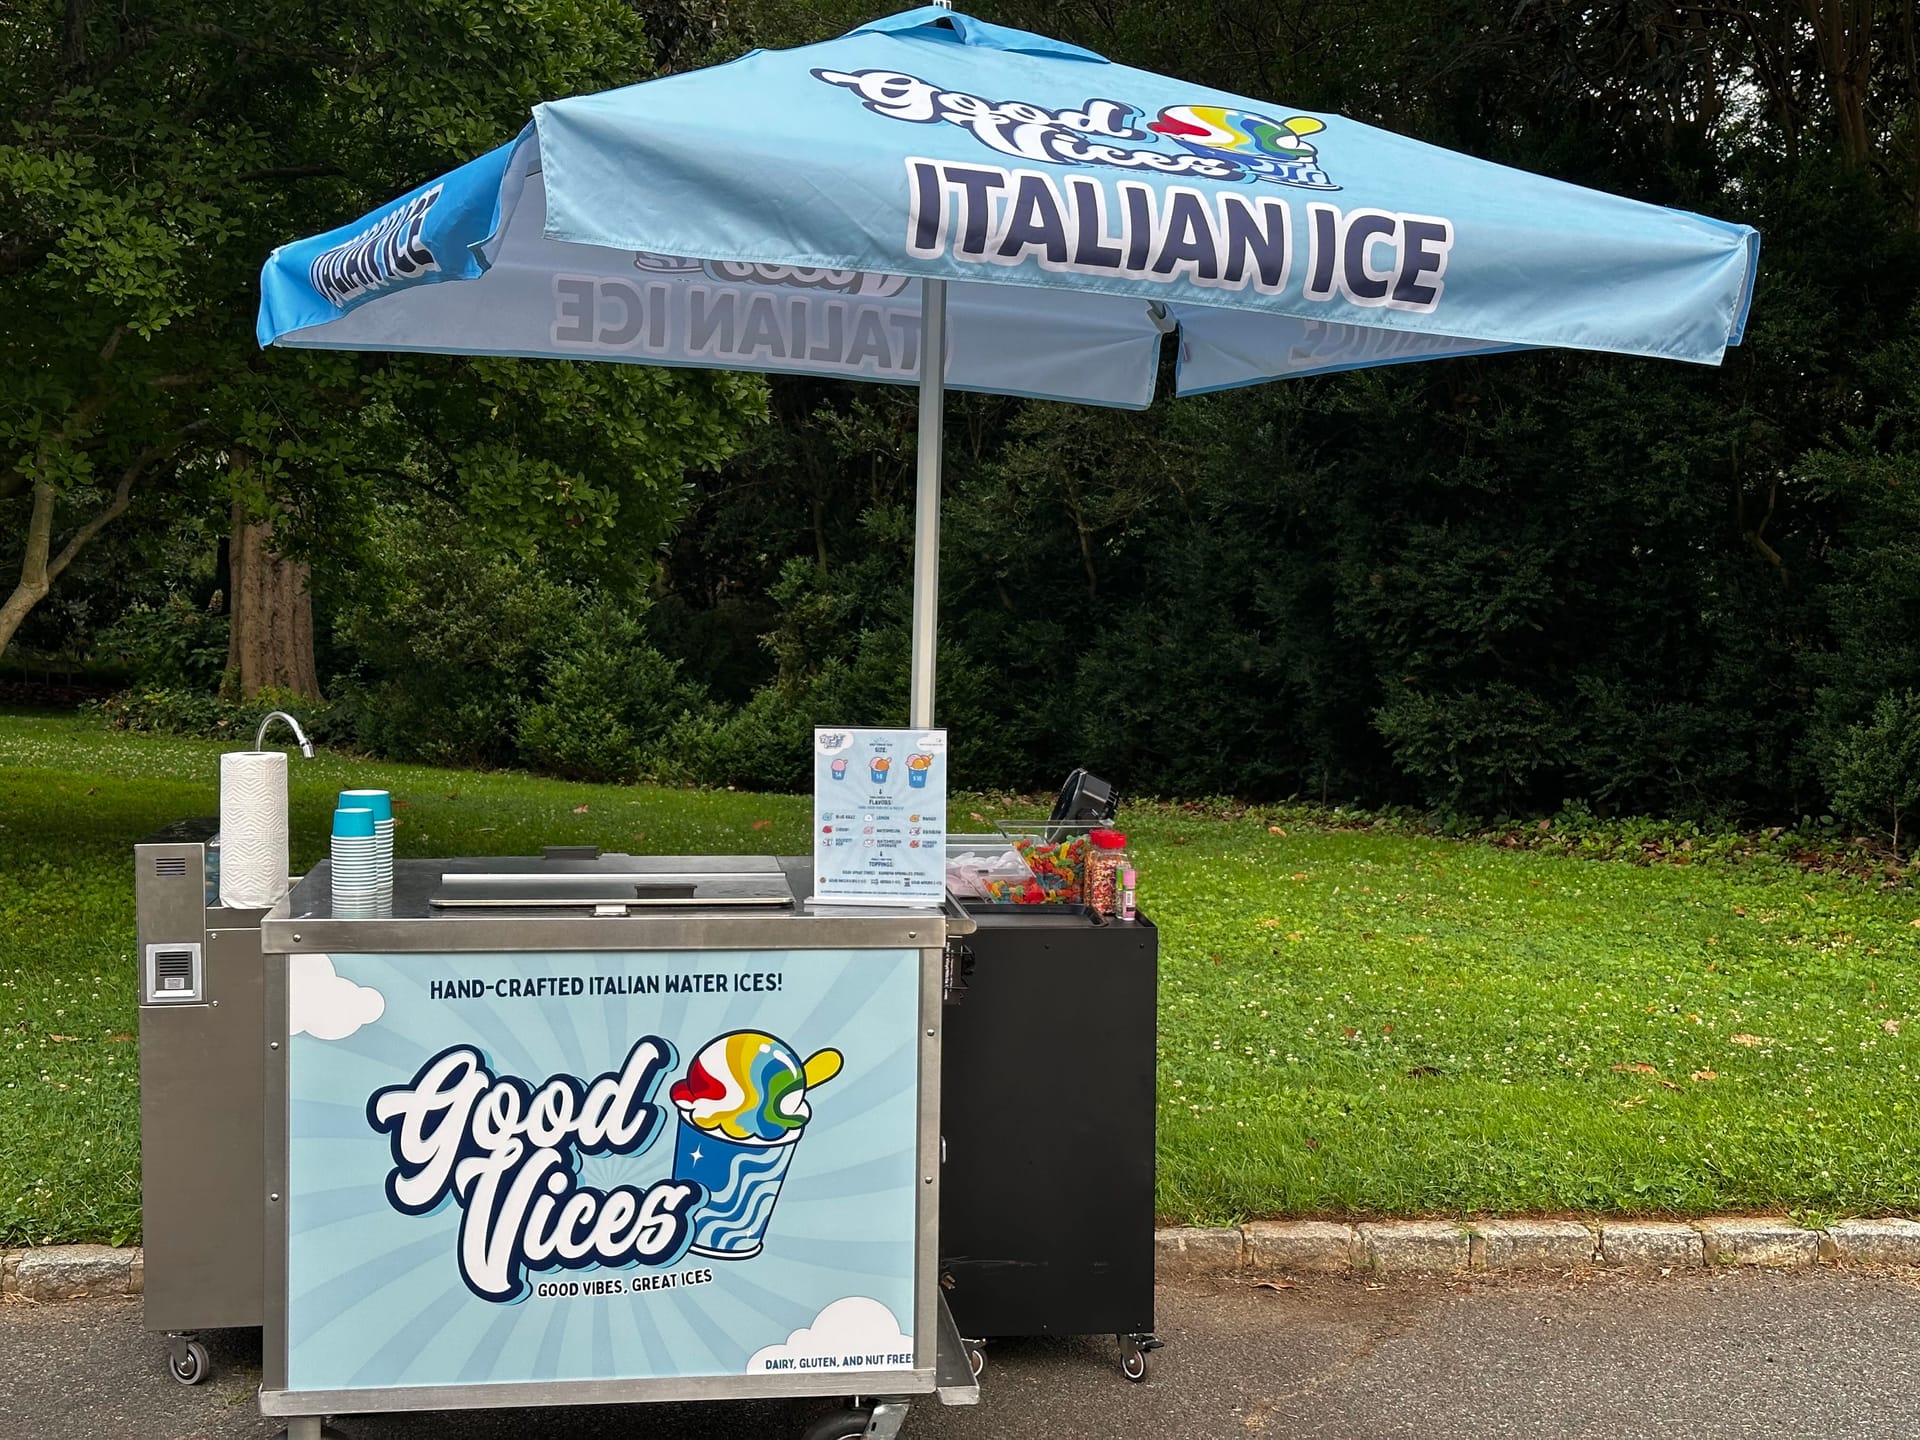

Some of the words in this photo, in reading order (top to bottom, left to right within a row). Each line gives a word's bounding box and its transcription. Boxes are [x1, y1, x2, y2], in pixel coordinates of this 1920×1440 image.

[809, 68, 1142, 140] Good
[942, 112, 1250, 180] Vices
[910, 160, 1288, 291] ITALIAN
[1310, 207, 1450, 306] ICE
[429, 974, 585, 1000] HAND-CRAFTED
[588, 974, 661, 998] ITALIAN
[664, 973, 730, 996] WATER
[733, 971, 784, 993] ICES!
[368, 1036, 677, 1214] Good
[452, 1142, 701, 1300] Vices
[536, 1280, 579, 1298] GOOD
[581, 1277, 630, 1296] VIBES,
[632, 1273, 678, 1292] GREAT
[680, 1268, 713, 1287] ICES
[765, 1358, 797, 1370] DAIRY,
[799, 1356, 840, 1368] GLUTEN,
[842, 1354, 863, 1366] AND
[865, 1354, 885, 1365] NUT
